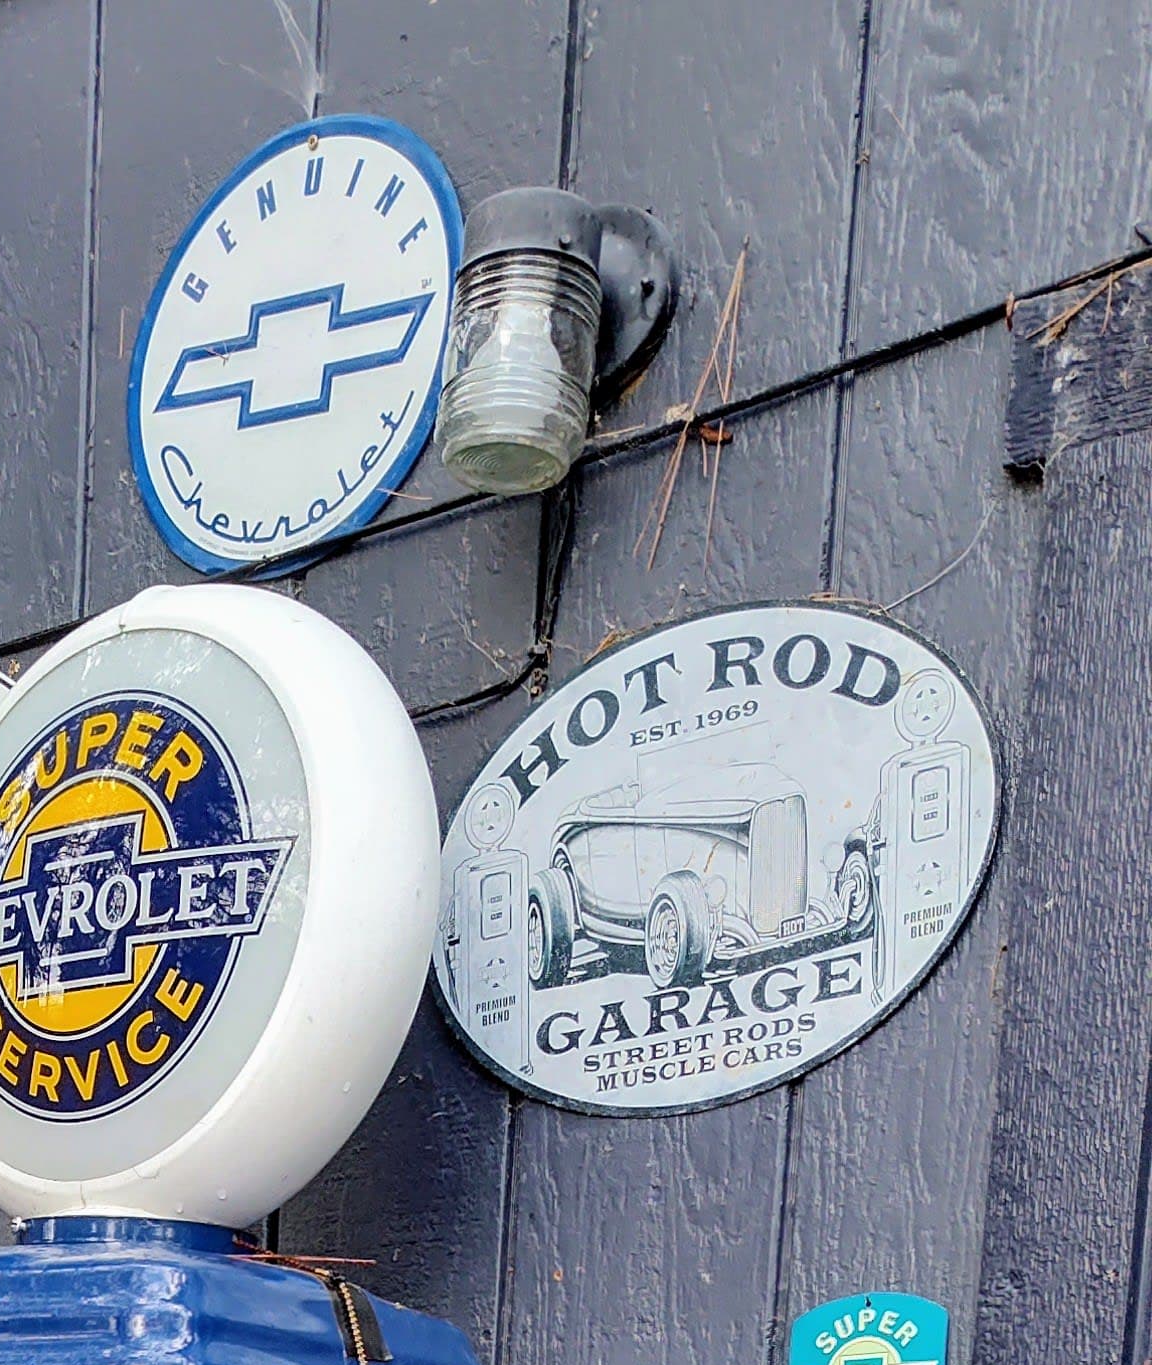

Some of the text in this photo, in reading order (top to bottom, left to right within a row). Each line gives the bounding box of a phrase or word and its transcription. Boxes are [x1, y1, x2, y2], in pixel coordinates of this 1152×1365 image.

[181, 156, 428, 303] GENUINE
[160, 390, 415, 543] Chevrolet
[499, 633, 901, 810] HOT ROD
[630, 700, 759, 747] EST. 1969
[783, 918, 806, 937] HOT
[903, 903, 953, 925] PREMIUM
[910, 919, 944, 940] BLEND
[475, 995, 516, 1014] PREMIUM
[481, 1009, 510, 1027] BLEND
[536, 952, 863, 1055] GARAGE
[583, 1013, 817, 1073] STREET RODS
[596, 1038, 803, 1092] MUSCLE CARS
[815, 1308, 919, 1354] SUPER
